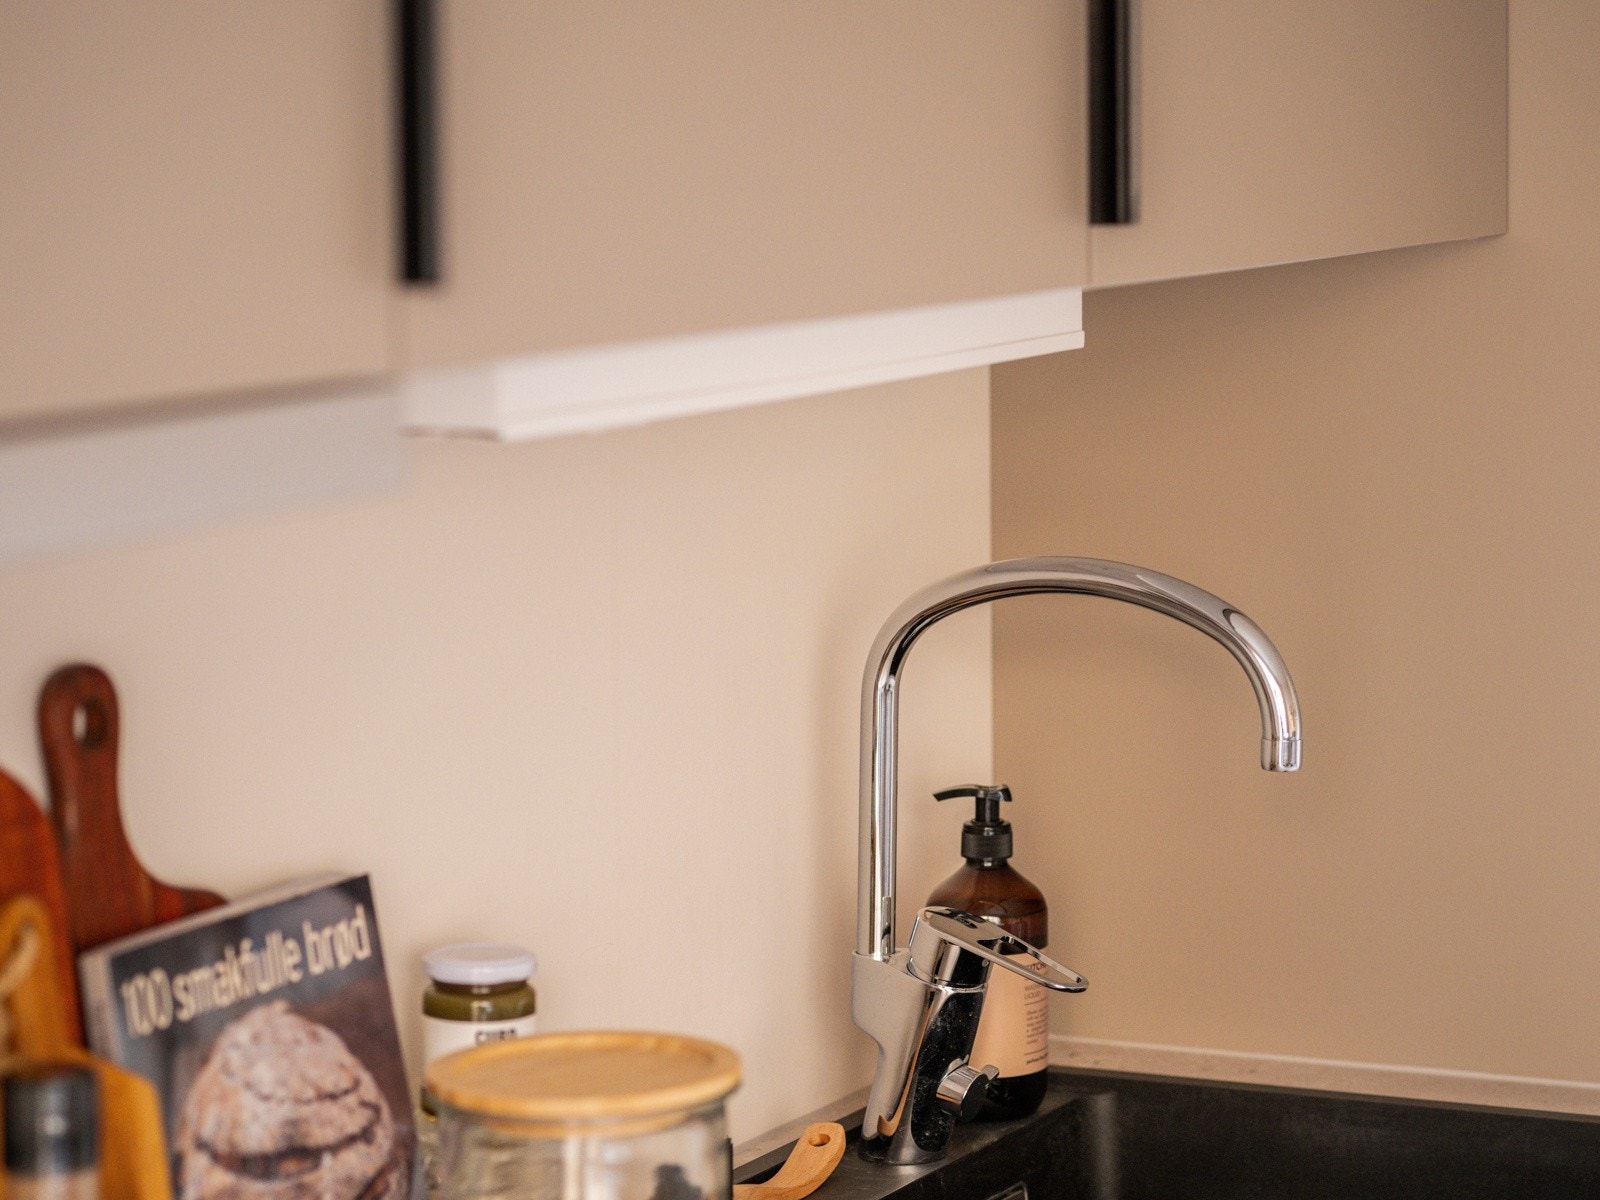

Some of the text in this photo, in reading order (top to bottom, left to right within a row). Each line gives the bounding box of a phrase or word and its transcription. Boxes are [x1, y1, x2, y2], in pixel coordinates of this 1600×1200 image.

[120, 903, 372, 1038] 100 smakfulle brød
